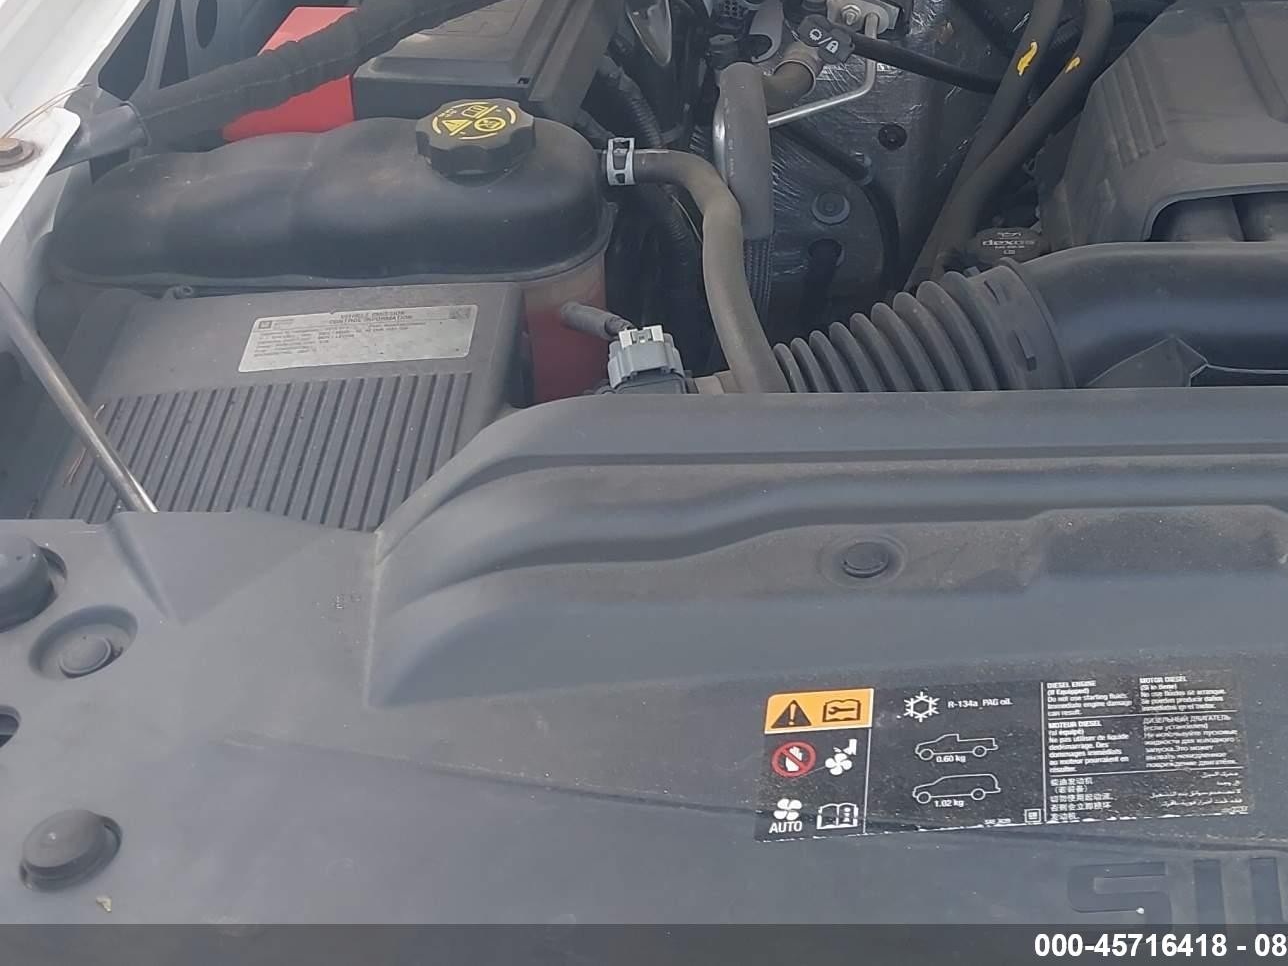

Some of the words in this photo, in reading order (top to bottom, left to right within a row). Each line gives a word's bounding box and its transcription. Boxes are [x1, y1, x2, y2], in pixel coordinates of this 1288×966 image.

[982, 698, 998, 707] PAG
[936, 755, 954, 763] 0.60
[955, 755, 966, 763] kg
[951, 800, 964, 808] kg
[769, 820, 802, 834] AUTO
